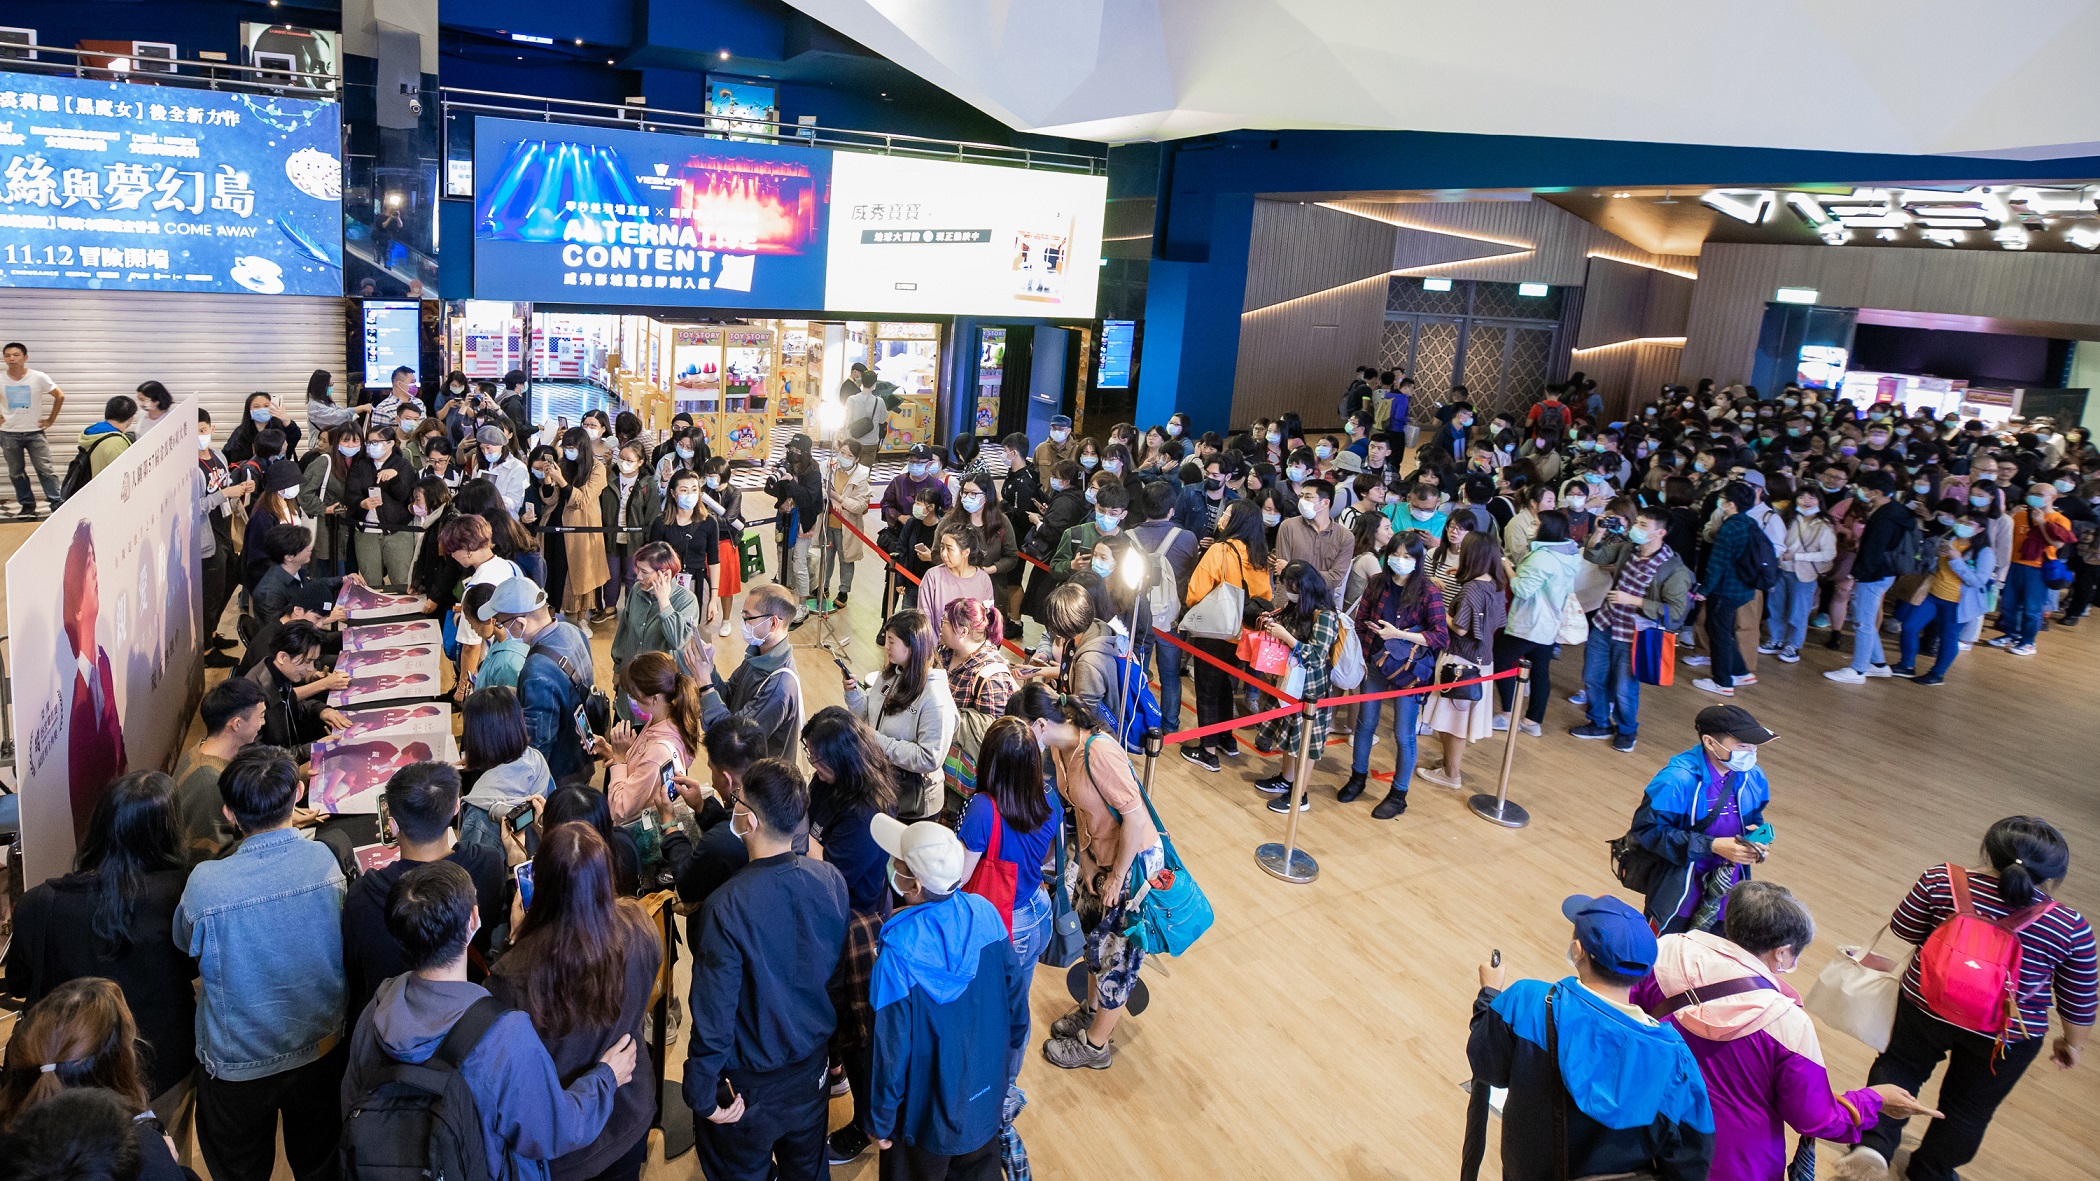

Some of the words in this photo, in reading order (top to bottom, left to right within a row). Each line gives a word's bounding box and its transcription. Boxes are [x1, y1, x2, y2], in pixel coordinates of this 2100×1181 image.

[0, 156, 256, 218] 絲與夢幻島
[164, 222, 212, 236] COME
[217, 225, 258, 238] AWAY
[4, 244, 74, 266] 11.12
[563, 244, 715, 272] CONTENT
[678, 331, 694, 340] TOY
[695, 331, 720, 339] STORY
[729, 332, 745, 341] TOY
